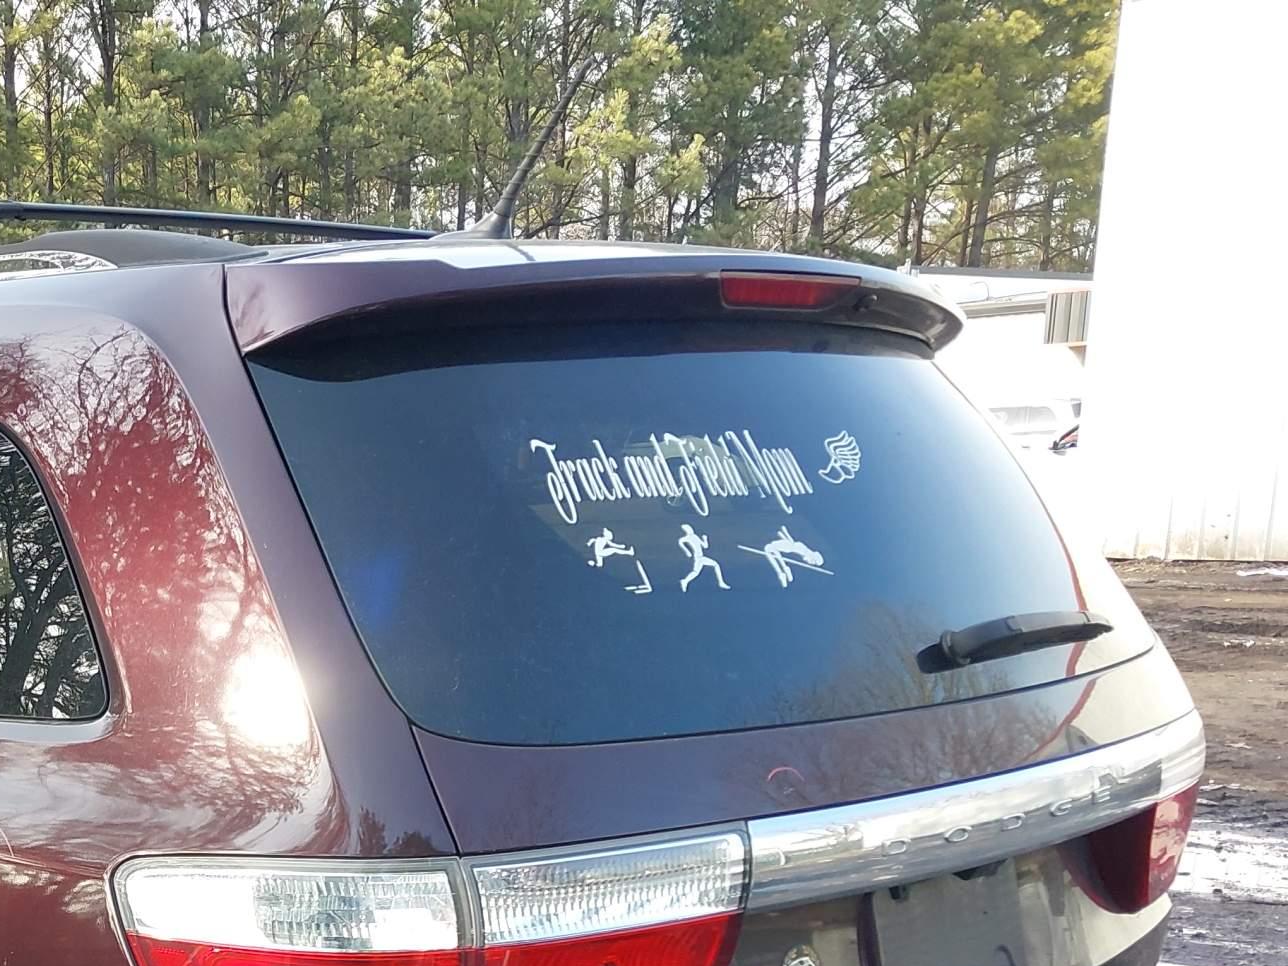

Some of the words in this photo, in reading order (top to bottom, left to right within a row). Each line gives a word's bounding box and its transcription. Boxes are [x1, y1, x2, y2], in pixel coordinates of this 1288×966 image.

[529, 438, 632, 525] Track
[623, 432, 684, 498] and
[663, 432, 749, 517] Field
[724, 429, 814, 515] Mom
[880, 784, 1113, 858] DODGE
